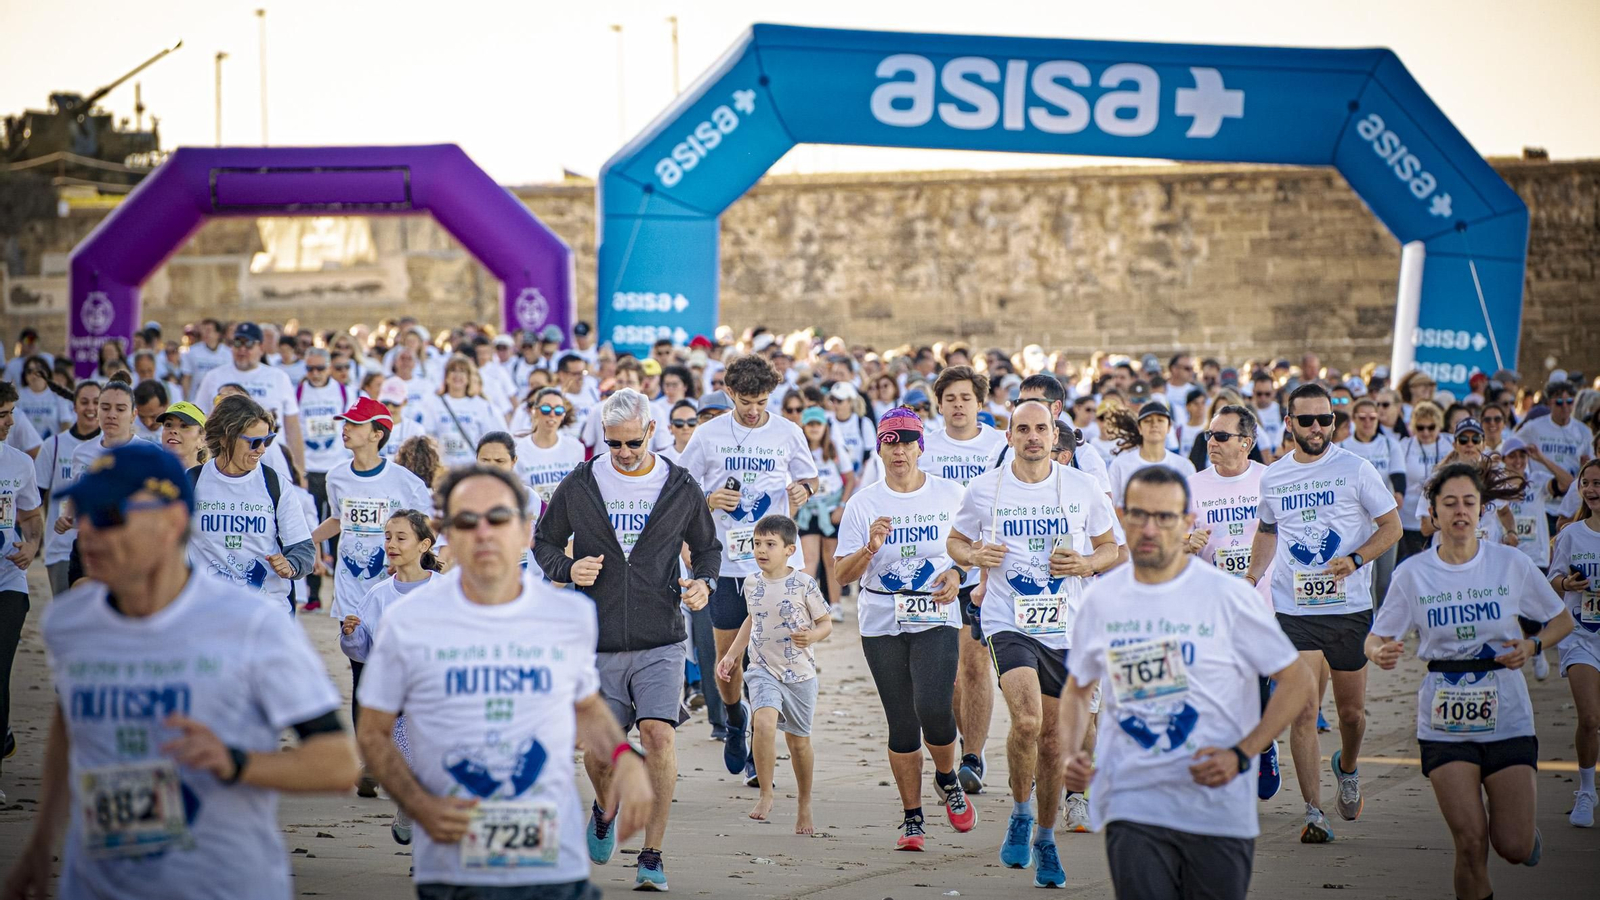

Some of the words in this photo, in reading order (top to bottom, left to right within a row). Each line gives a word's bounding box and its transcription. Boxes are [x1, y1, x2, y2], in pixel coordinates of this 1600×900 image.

[870, 54, 1161, 137] asisa
[654, 104, 740, 188] asisa
[1356, 113, 1437, 200] asisa
[755, 446, 774, 455] favor
[937, 454, 962, 463] marcha
[725, 456, 776, 472] AUTISMO
[1276, 483, 1301, 495] marcha
[1304, 482, 1309, 490] a
[1311, 480, 1331, 490] favor
[1335, 477, 1347, 487] del
[196, 501, 226, 511] marcha
[230, 502, 235, 511] a
[240, 501, 264, 512] favor
[628, 501, 634, 510] a
[1201, 496, 1227, 508] marcha
[1230, 496, 1235, 504] a
[1281, 490, 1335, 511] AUTISMO
[350, 508, 377, 524] 851
[904, 516, 910, 524] a
[913, 513, 935, 523] favor
[939, 511, 949, 522] del
[997, 506, 1028, 517] marcha
[1031, 507, 1037, 516] a
[1069, 503, 1080, 513] del
[201, 514, 266, 533] AUTISMO
[1003, 517, 1069, 537] AUTISMO
[1571, 551, 1596, 561] marcha
[1304, 580, 1336, 597] 992
[1419, 590, 1452, 606] marcha
[1457, 590, 1462, 600] a
[1467, 587, 1493, 599] favor
[1498, 584, 1510, 597] del
[906, 597, 937, 613] 201
[1026, 606, 1058, 624] 272
[1427, 601, 1501, 629] AUTISMO
[1121, 655, 1166, 685] 767
[446, 666, 553, 695] AUTISMO
[1439, 701, 1492, 721] 1086
[483, 823, 540, 849] 728
